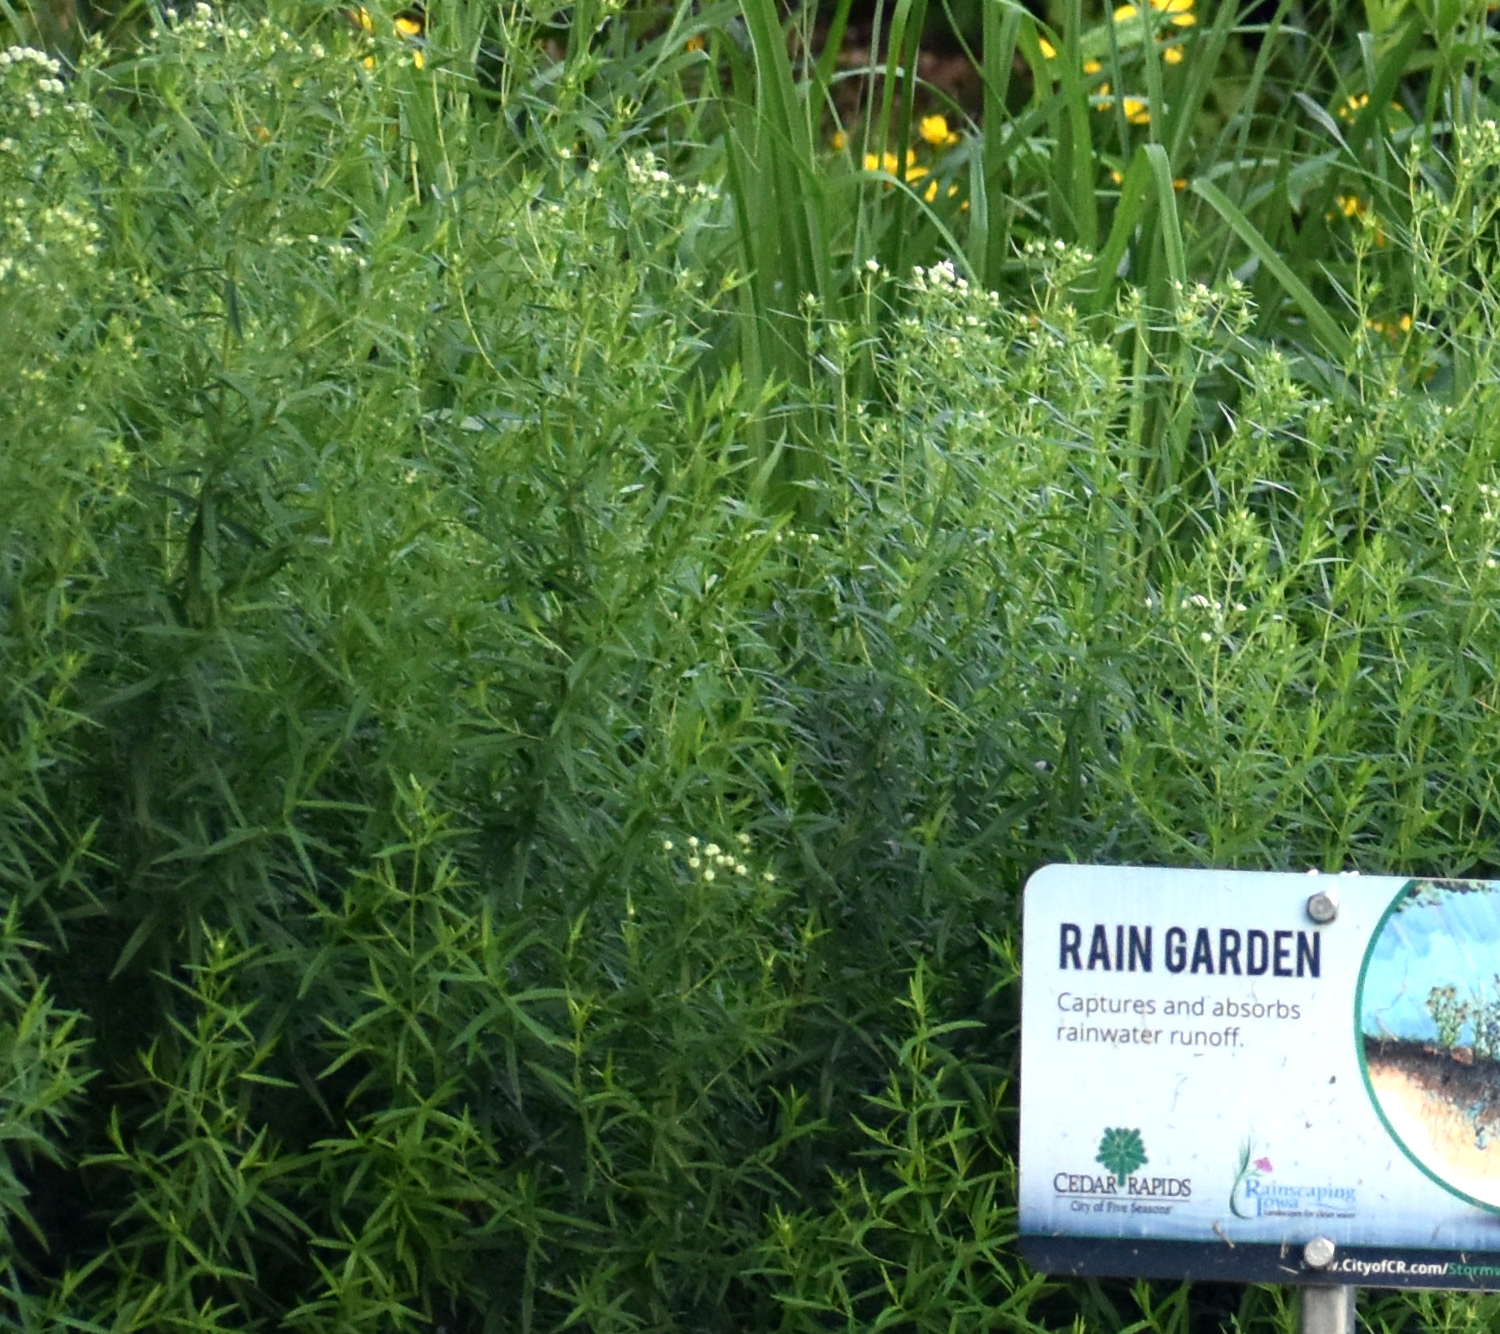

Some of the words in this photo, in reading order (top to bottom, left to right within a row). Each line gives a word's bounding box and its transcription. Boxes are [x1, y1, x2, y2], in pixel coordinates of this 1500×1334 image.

[1059, 922, 1153, 973] RAIN
[1164, 926, 1321, 978] GARDEN
[1057, 992, 1156, 1016] Captures
[1163, 997, 1205, 1016] and
[1212, 998, 1301, 1019] absorbs
[1057, 1023, 1163, 1044] rainwater
[1170, 1027, 1244, 1047] runoff.
[1053, 1172, 1117, 1194] CEDAR
[1128, 1177, 1192, 1197] RAPIDS
[1245, 1179, 1357, 1203] Rainscaping
[1070, 1200, 1091, 1214] City
[1093, 1200, 1105, 1213] of
[1257, 1196, 1299, 1217] Iowa
